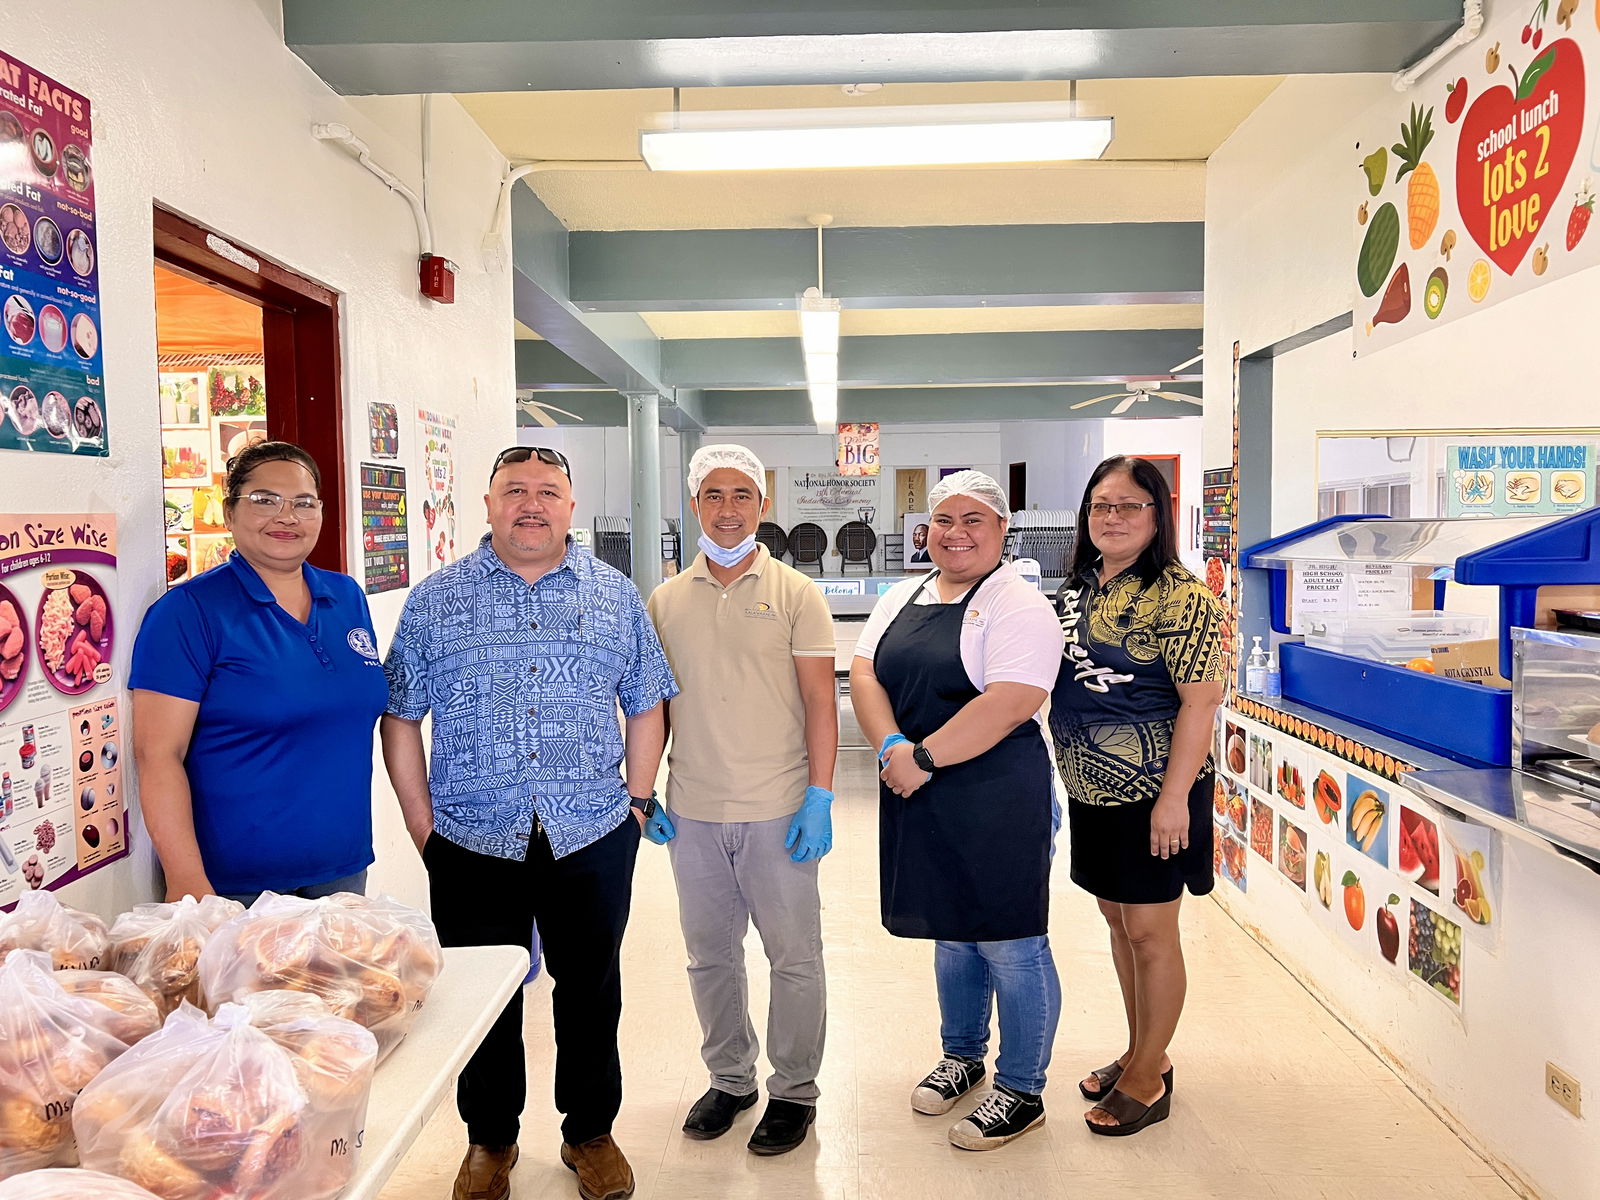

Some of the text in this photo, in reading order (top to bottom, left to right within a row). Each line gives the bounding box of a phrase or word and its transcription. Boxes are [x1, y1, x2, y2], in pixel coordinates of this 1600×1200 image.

[28, 73, 83, 122] FACTS
[28, 98, 43, 116] Fat
[70, 124, 89, 139] good
[1477, 89, 1559, 162] school lunch
[1483, 124, 1550, 207] lots 2
[25, 185, 42, 202] Fat
[56, 201, 93, 222] not-so-bad
[1489, 192, 1541, 252] love
[57, 286, 96, 304] not-so-good
[86, 374, 100, 386] bad
[844, 444, 875, 465] BIG
[1458, 445, 1587, 470] WASH YOUR HANDS!
[794, 476, 877, 489] NATIONAL HONOR SOCIETY
[24, 522, 65, 549] Size
[70, 522, 108, 548] Wise
[10, 557, 29, 571] children
[29, 556, 40, 567] ages
[40, 552, 51, 563] 6-12
[1460, 666, 1494, 678] CRYSTAL
